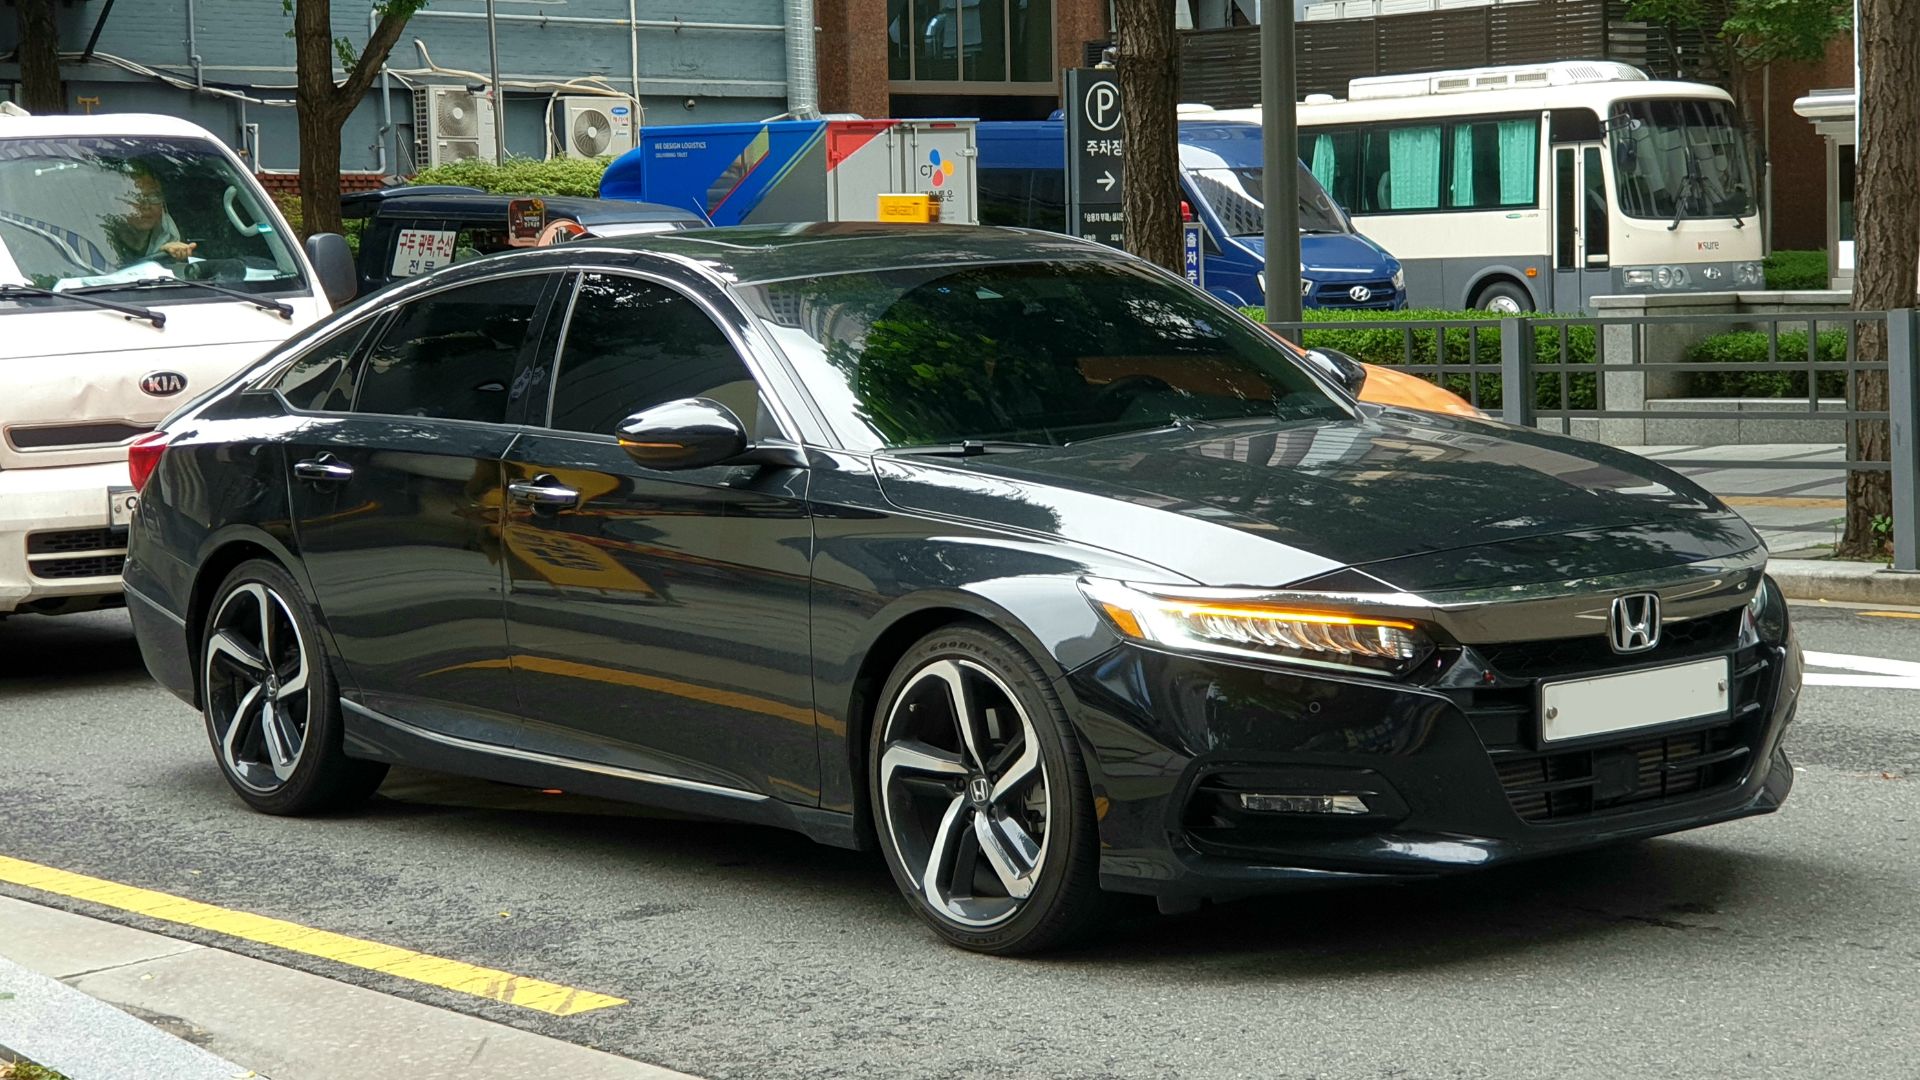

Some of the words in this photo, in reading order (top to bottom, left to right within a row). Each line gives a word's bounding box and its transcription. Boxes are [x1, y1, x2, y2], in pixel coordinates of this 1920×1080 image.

[681, 141, 706, 149] LOGISTICS
[920, 165, 933, 178] CJ
[400, 233, 416, 256] 구두
[147, 375, 181, 392] KIA
